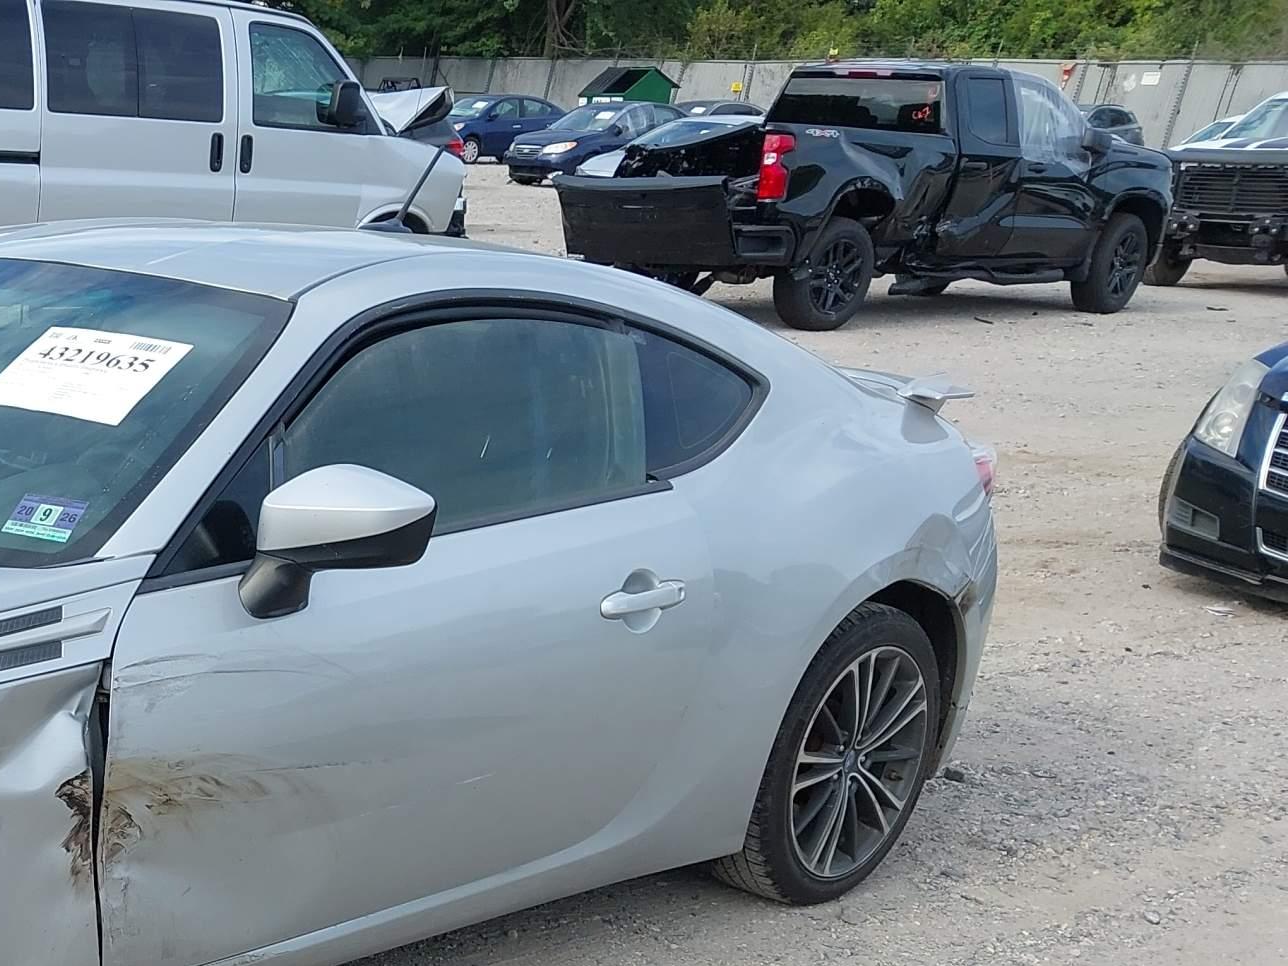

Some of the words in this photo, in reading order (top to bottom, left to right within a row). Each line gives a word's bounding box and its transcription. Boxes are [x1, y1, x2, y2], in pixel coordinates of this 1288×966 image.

[37, 345, 156, 373] 43219635
[17, 505, 34, 516] 20
[39, 508, 53, 522] 9
[60, 512, 78, 523] 26
